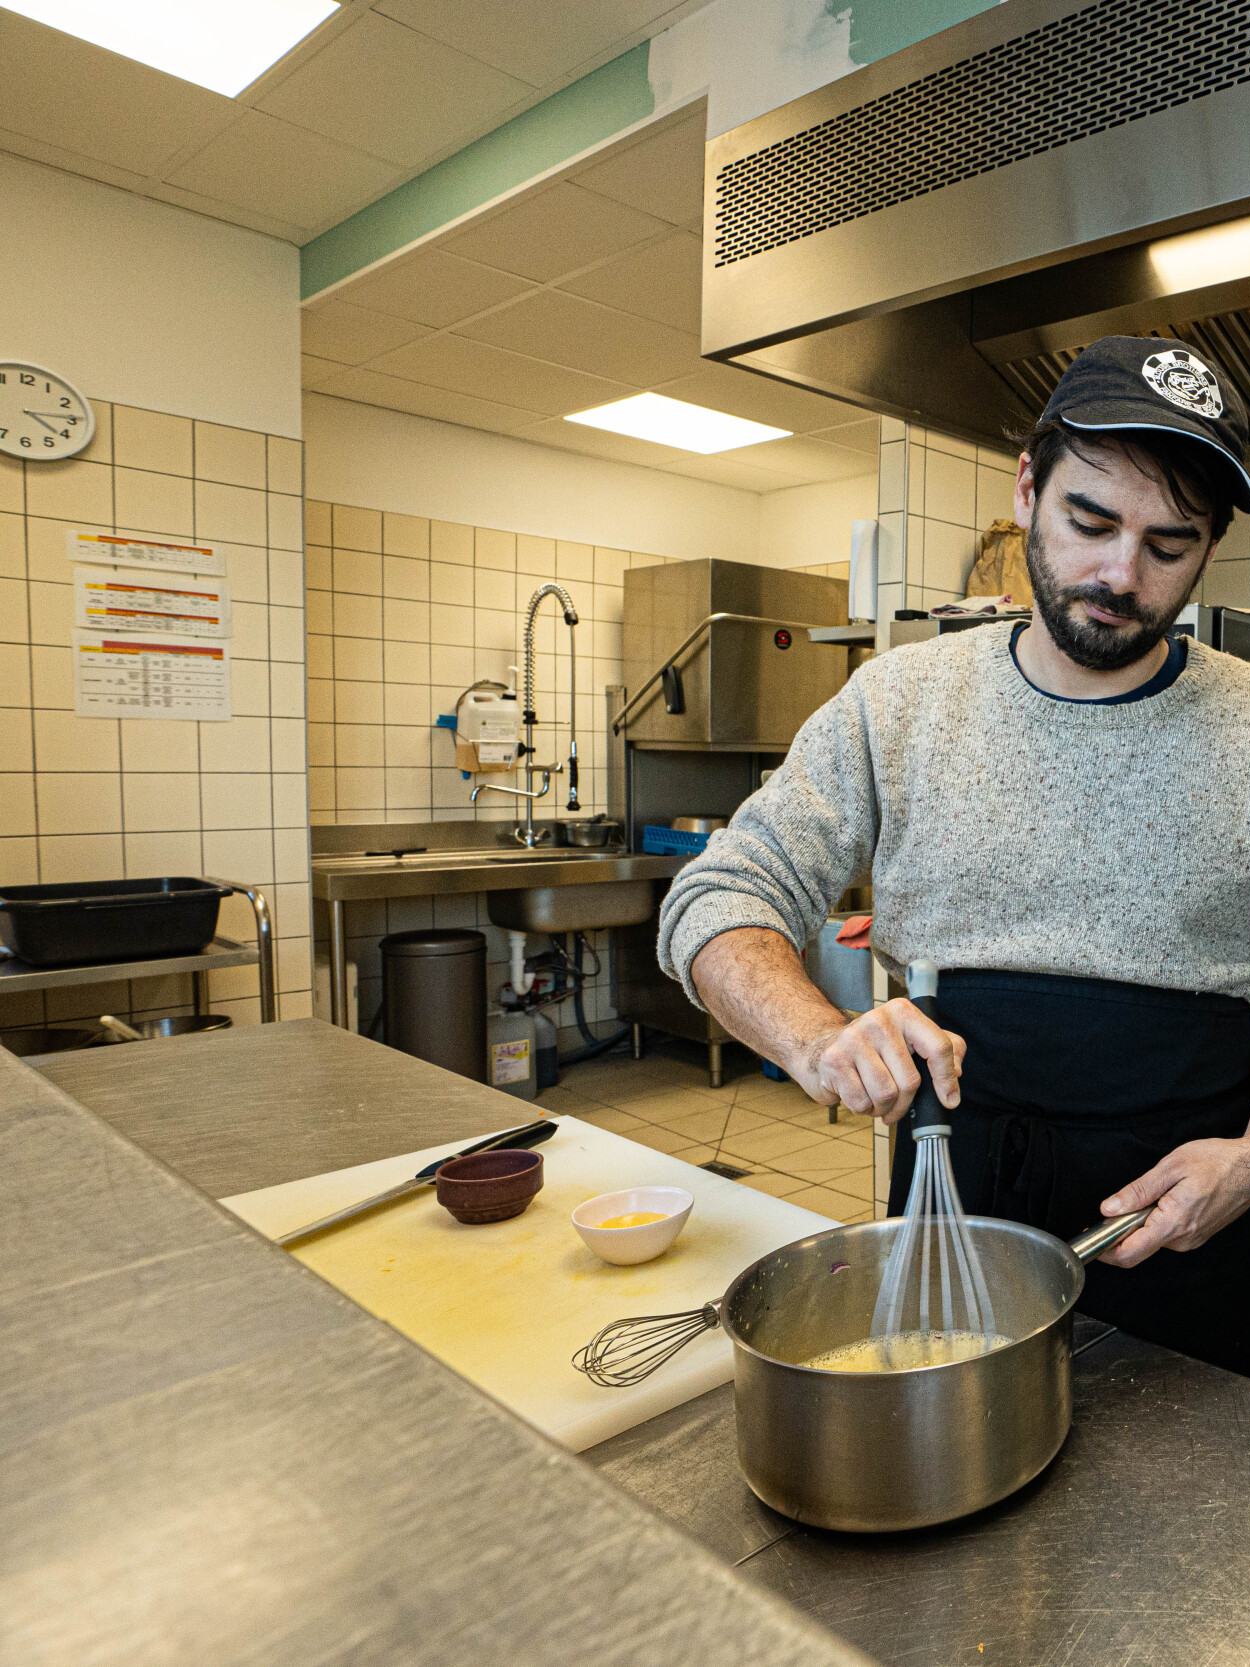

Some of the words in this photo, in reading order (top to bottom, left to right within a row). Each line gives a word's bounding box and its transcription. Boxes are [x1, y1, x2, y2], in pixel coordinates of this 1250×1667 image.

[19, 372, 36, 387] 12
[45, 382, 50, 394] 1
[59, 397, 71, 409] 2
[66, 414, 78, 426] 3
[0, 427, 9, 439] 7
[59, 428, 71, 440] 4
[19, 436, 32, 448] 6
[43, 436, 55, 448] 5
